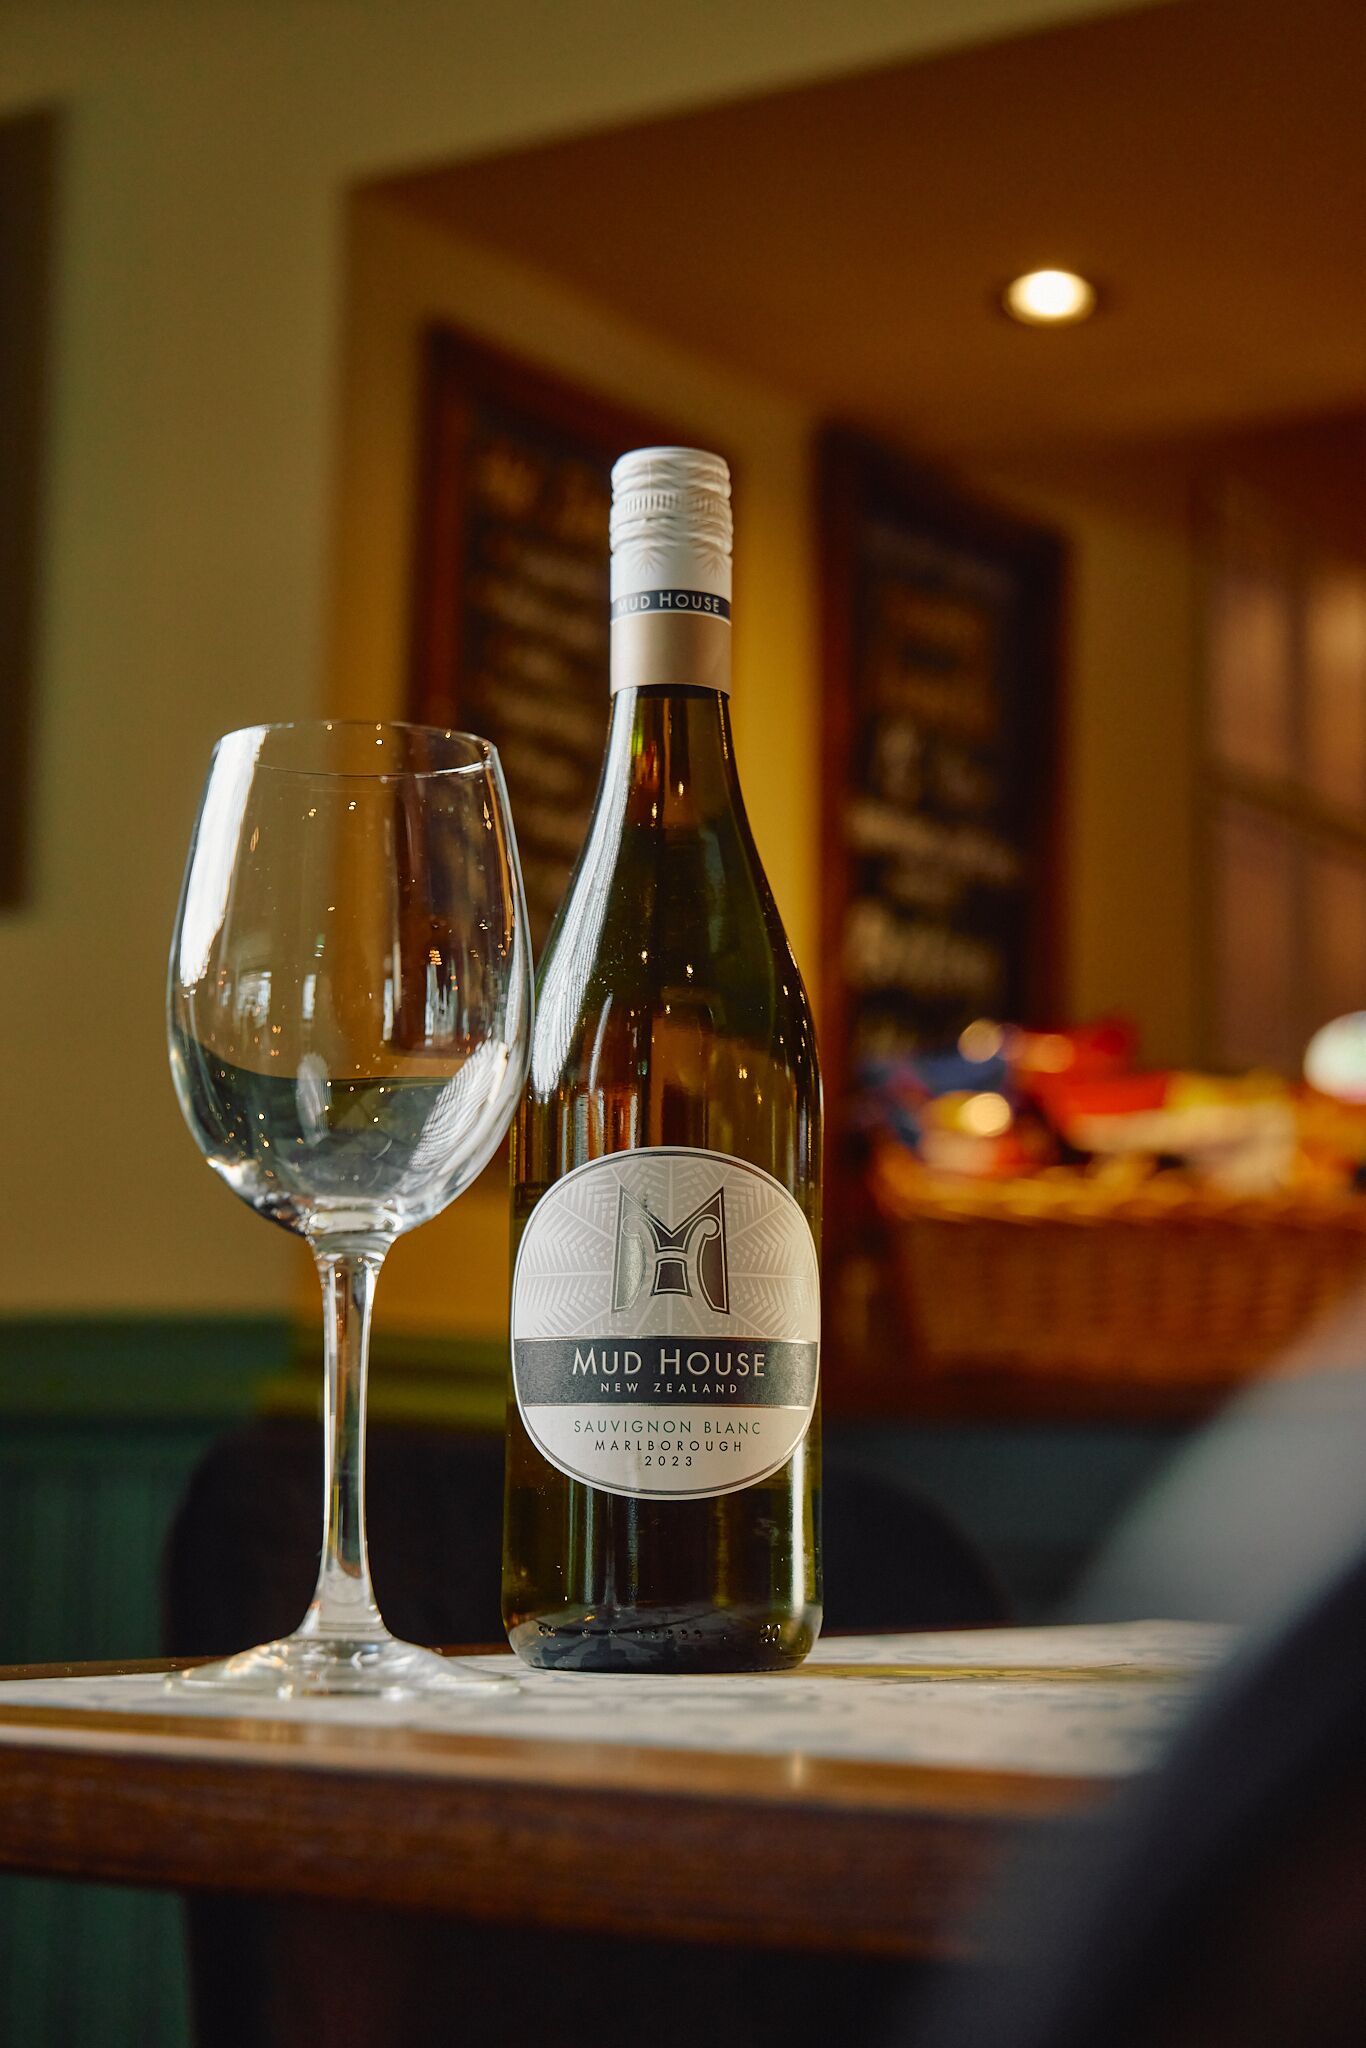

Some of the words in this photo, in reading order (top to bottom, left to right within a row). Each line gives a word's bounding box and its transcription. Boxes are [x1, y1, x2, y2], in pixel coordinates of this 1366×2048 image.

[618, 594, 650, 613] MUD
[659, 592, 720, 613] HOUSE
[572, 1347, 642, 1376] MUD
[660, 1348, 765, 1377] HOUSE
[600, 1382, 639, 1393] NEW
[654, 1382, 738, 1394] ZEALAND
[574, 1420, 692, 1434] SAUVIGNON
[704, 1421, 761, 1435] BLANC
[595, 1439, 742, 1452] MARLBOROUGH
[644, 1455, 693, 1467] 2023
